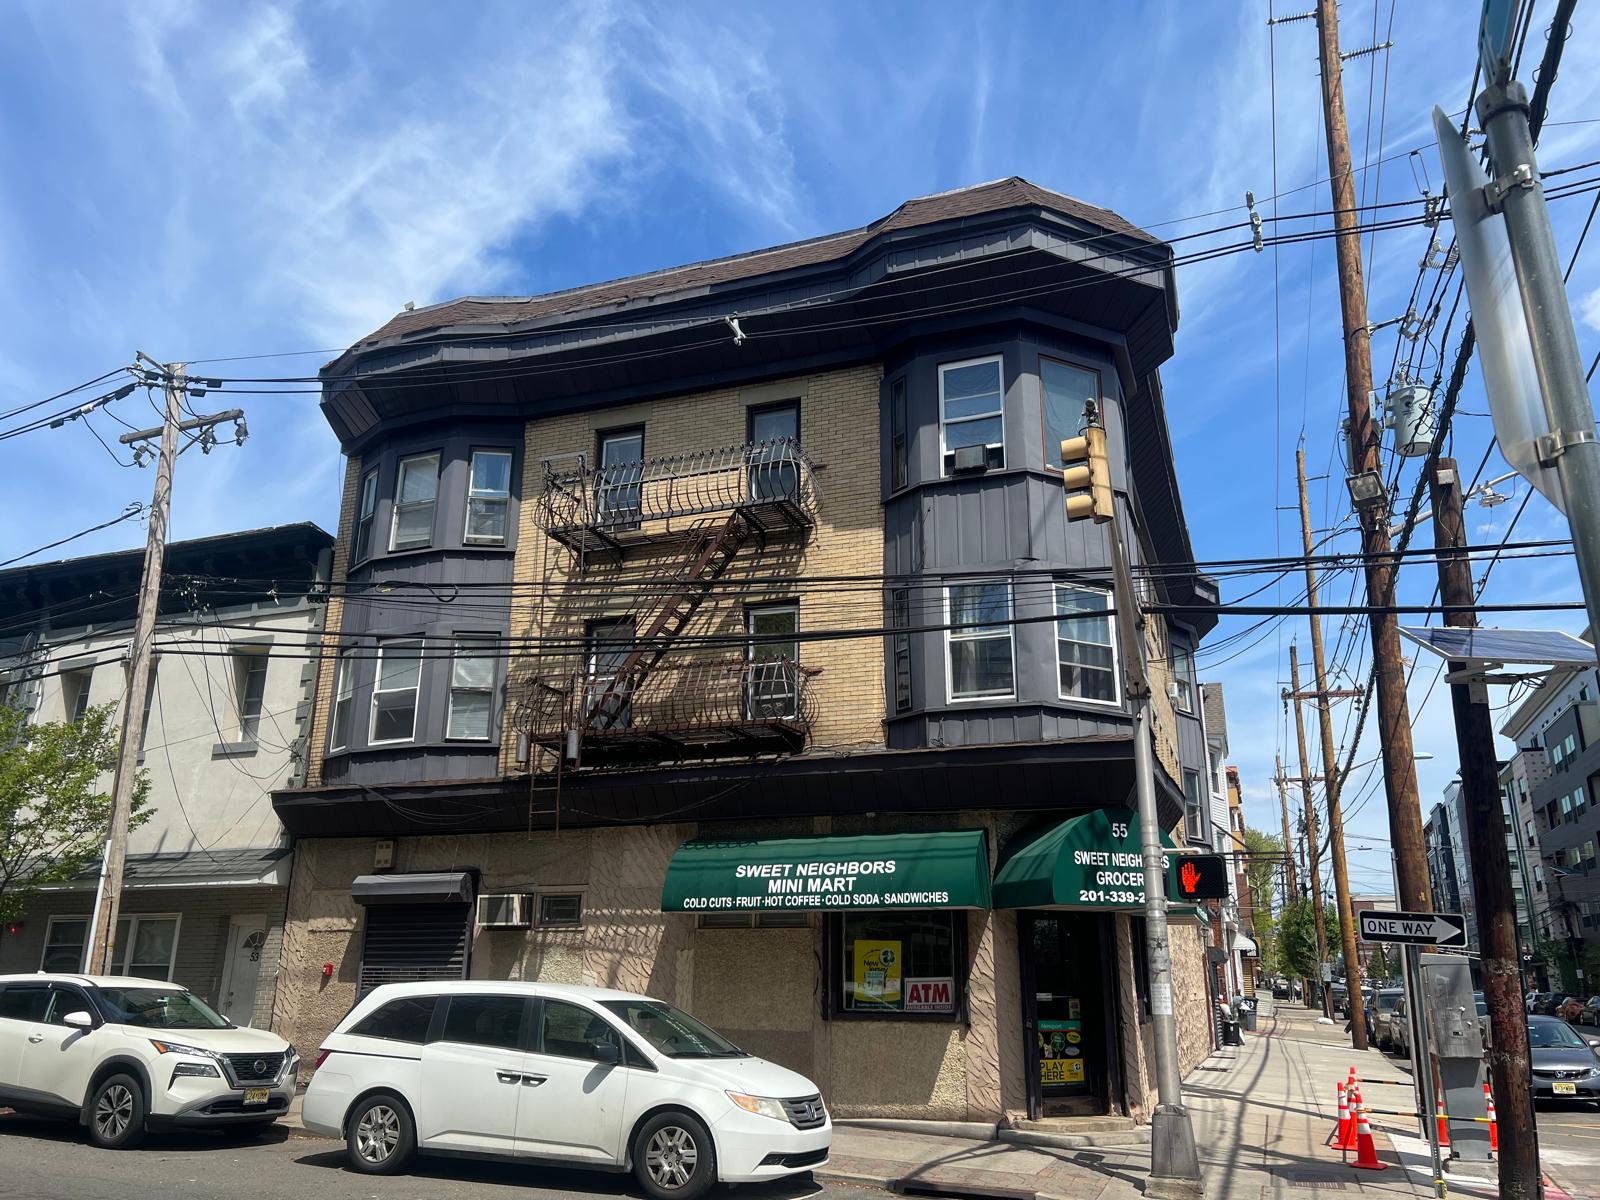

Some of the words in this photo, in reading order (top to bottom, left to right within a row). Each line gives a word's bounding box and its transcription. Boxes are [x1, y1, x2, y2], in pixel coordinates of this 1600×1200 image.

[1112, 823, 1128, 838] 55
[1074, 851, 1110, 866] SWEET
[1111, 852, 1170, 869] NEIGHS
[735, 864, 793, 878] SWEET
[795, 860, 896, 876] NEIGHBORS
[767, 879, 803, 894] MINI
[807, 877, 857, 893] MART
[1096, 871, 1145, 887] GROCER
[683, 897, 708, 909] COLD
[1367, 920, 1398, 934] ONE
[1401, 921, 1433, 936] WAY
[249, 952, 259, 962] 53
[863, 959, 880, 968] New
[907, 983, 950, 1004] ATM
[1040, 1061, 1065, 1071] PLAY
[1040, 1071, 1065, 1081] HERE
